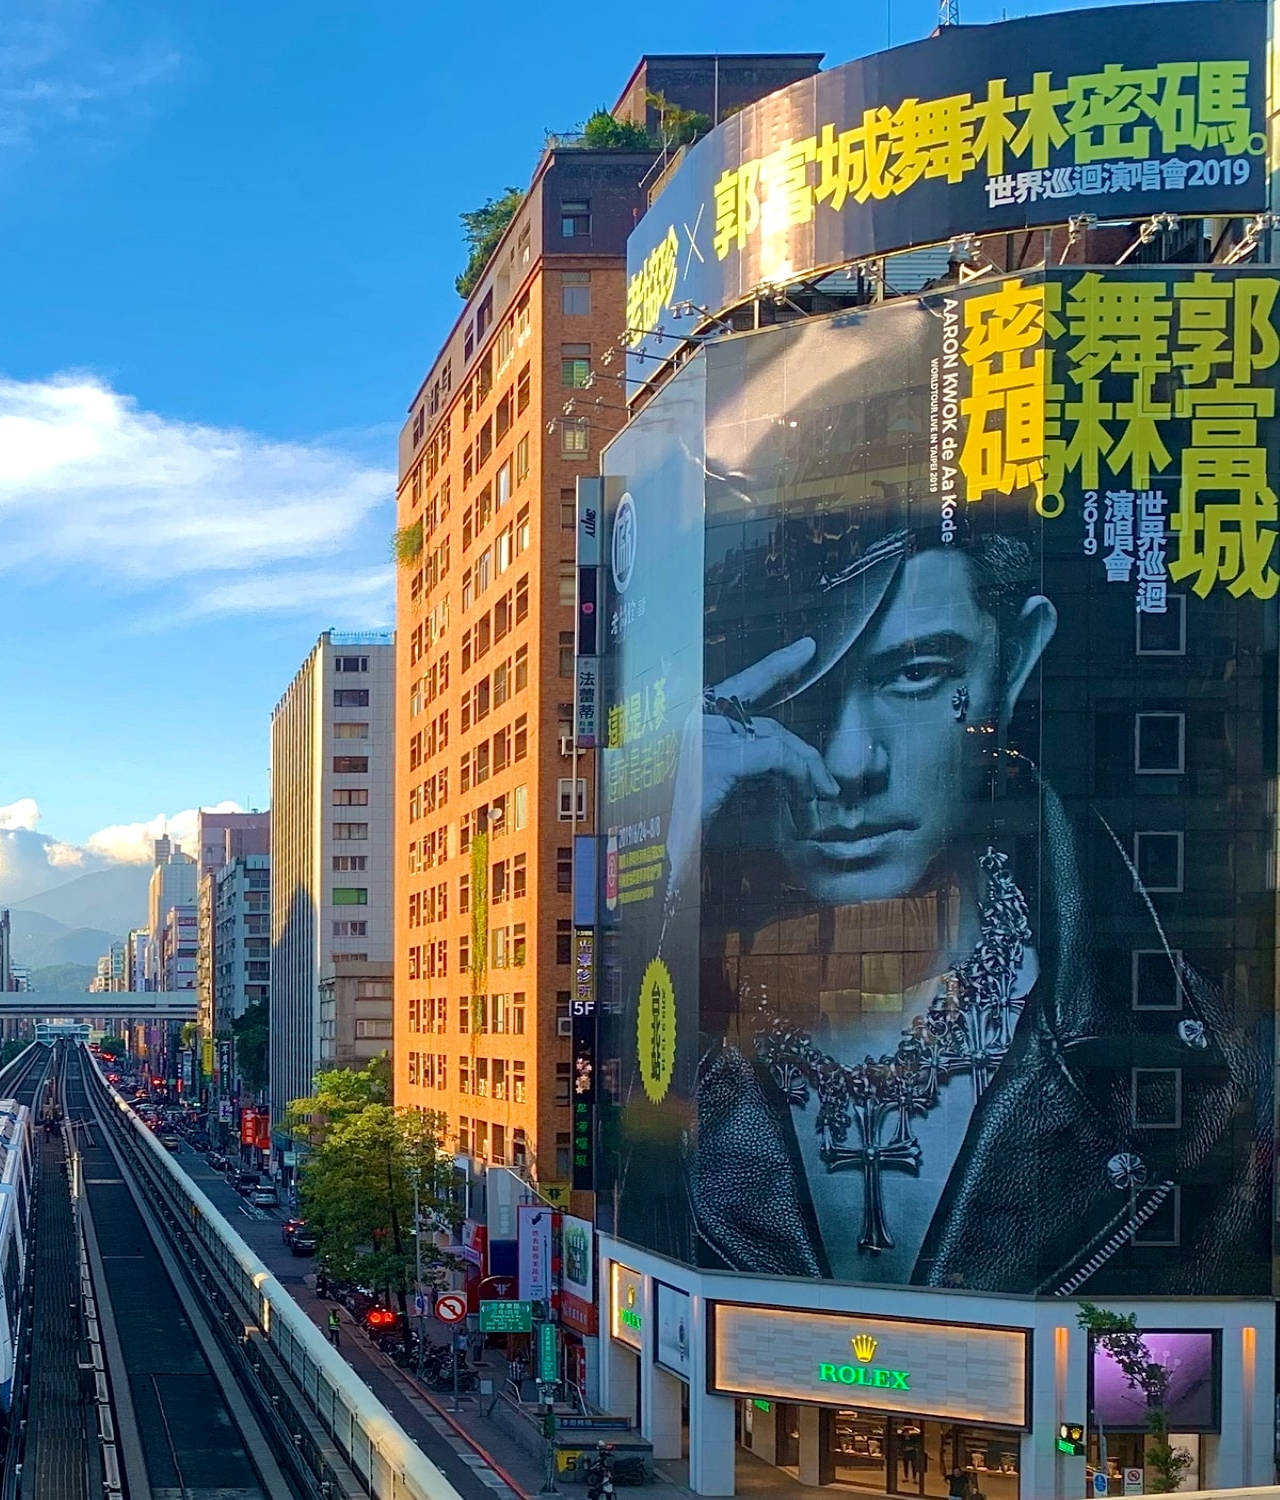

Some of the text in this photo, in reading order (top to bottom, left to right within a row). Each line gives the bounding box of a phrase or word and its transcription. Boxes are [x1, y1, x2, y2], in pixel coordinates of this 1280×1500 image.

[986, 157, 1251, 209] 世界巡迴演唱會2019
[1066, 271, 1173, 490] 舞林
[930, 414, 939, 432] LIVE
[941, 298, 959, 543] AARON KWOK de Aa Kode
[1167, 272, 1280, 600] 郭富城
[930, 444, 939, 471] TAIPEI
[930, 472, 939, 492] 2019
[1083, 491, 1099, 556] 2019
[1103, 489, 1135, 582] 演唱會
[1136, 489, 1170, 614] 世界巡迴
[573, 1000, 595, 1016] 5F
[819, 1362, 911, 1390] ROLEX
[565, 1456, 577, 1471] 5
